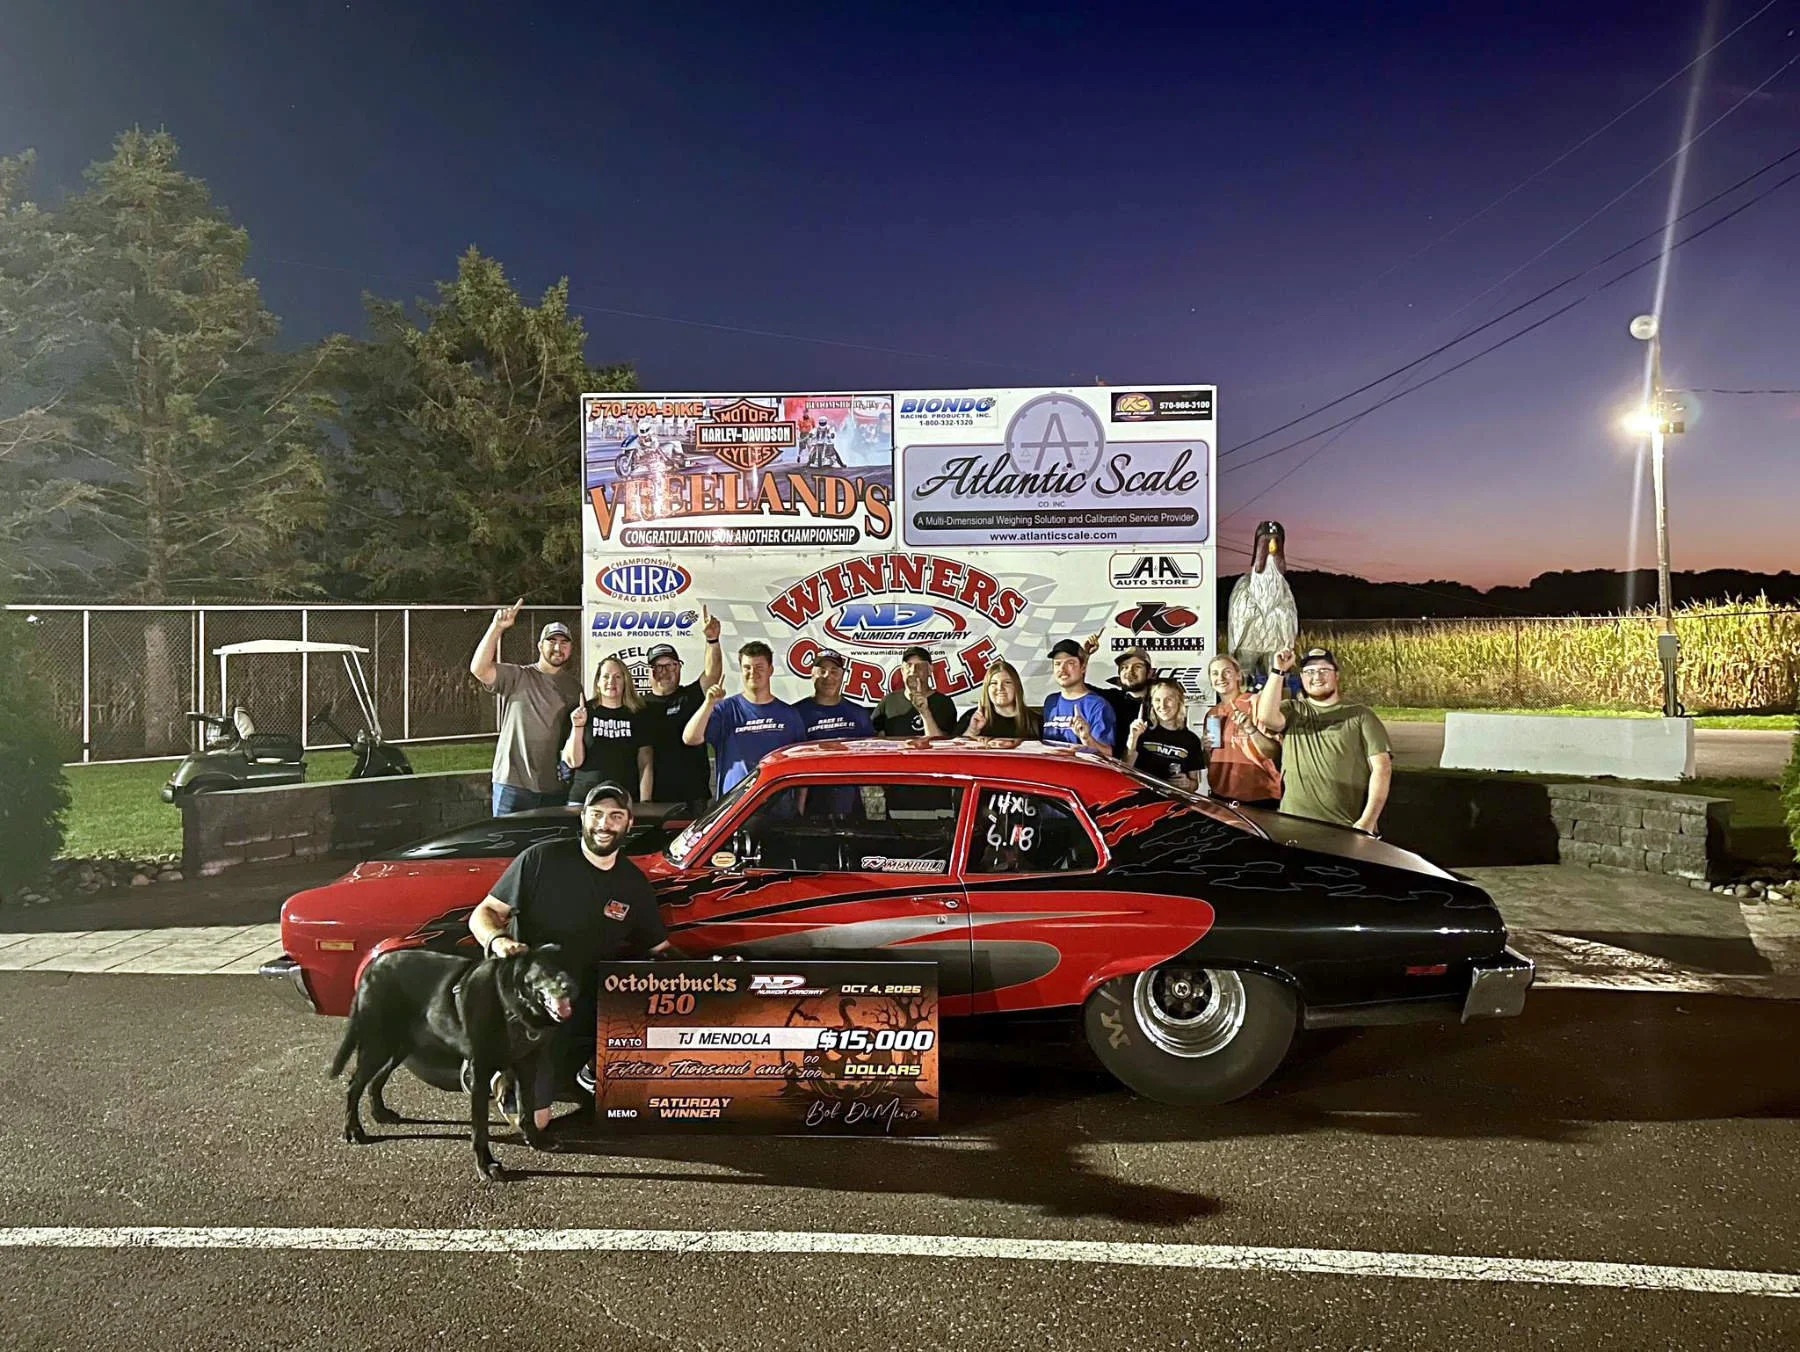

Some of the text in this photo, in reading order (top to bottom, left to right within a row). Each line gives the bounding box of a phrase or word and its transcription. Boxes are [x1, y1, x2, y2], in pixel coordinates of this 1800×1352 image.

[591, 402, 704, 418] 570-784-BIKE
[900, 397, 995, 413] BIONDO
[721, 405, 768, 422] MOTOR
[701, 427, 790, 442] HARLEY-DAVIDSON
[722, 447, 771, 466] CYCLES
[916, 448, 1199, 497] Atlantic Scale
[917, 512, 1195, 526] A Multi-Dimensional Weighing Solution and Calibration Service Provider
[625, 528, 855, 545] CONGRATULATIONS ON ANOTHER CHAMPIONSHIP
[990, 531, 1118, 541] www.atlanticscale.com
[611, 558, 677, 569] CHAMPIONSHIP
[611, 565, 678, 594] NHRA
[611, 591, 677, 602] DRAG RACING
[768, 553, 1027, 629] WINNERS
[592, 611, 697, 629] BIONDO
[852, 631, 971, 640] NUMIDIA DRAGWAY
[1111, 638, 1148, 646] KOREK
[604, 972, 737, 992] Octoberbucks
[841, 984, 921, 995] OCT 4, 2025
[647, 993, 696, 1015] 150
[608, 1038, 643, 1047] PAY TO
[679, 1033, 771, 1045] TJ MENDOLA
[817, 1029, 935, 1053] $15,000
[605, 1061, 667, 1078] Fifteen
[669, 1059, 751, 1077] Thousand
[844, 1064, 921, 1076] DOLLARS
[648, 1097, 731, 1108] SATURDAY
[607, 1109, 638, 1119] MEMO
[659, 1108, 721, 1119] WINNER
